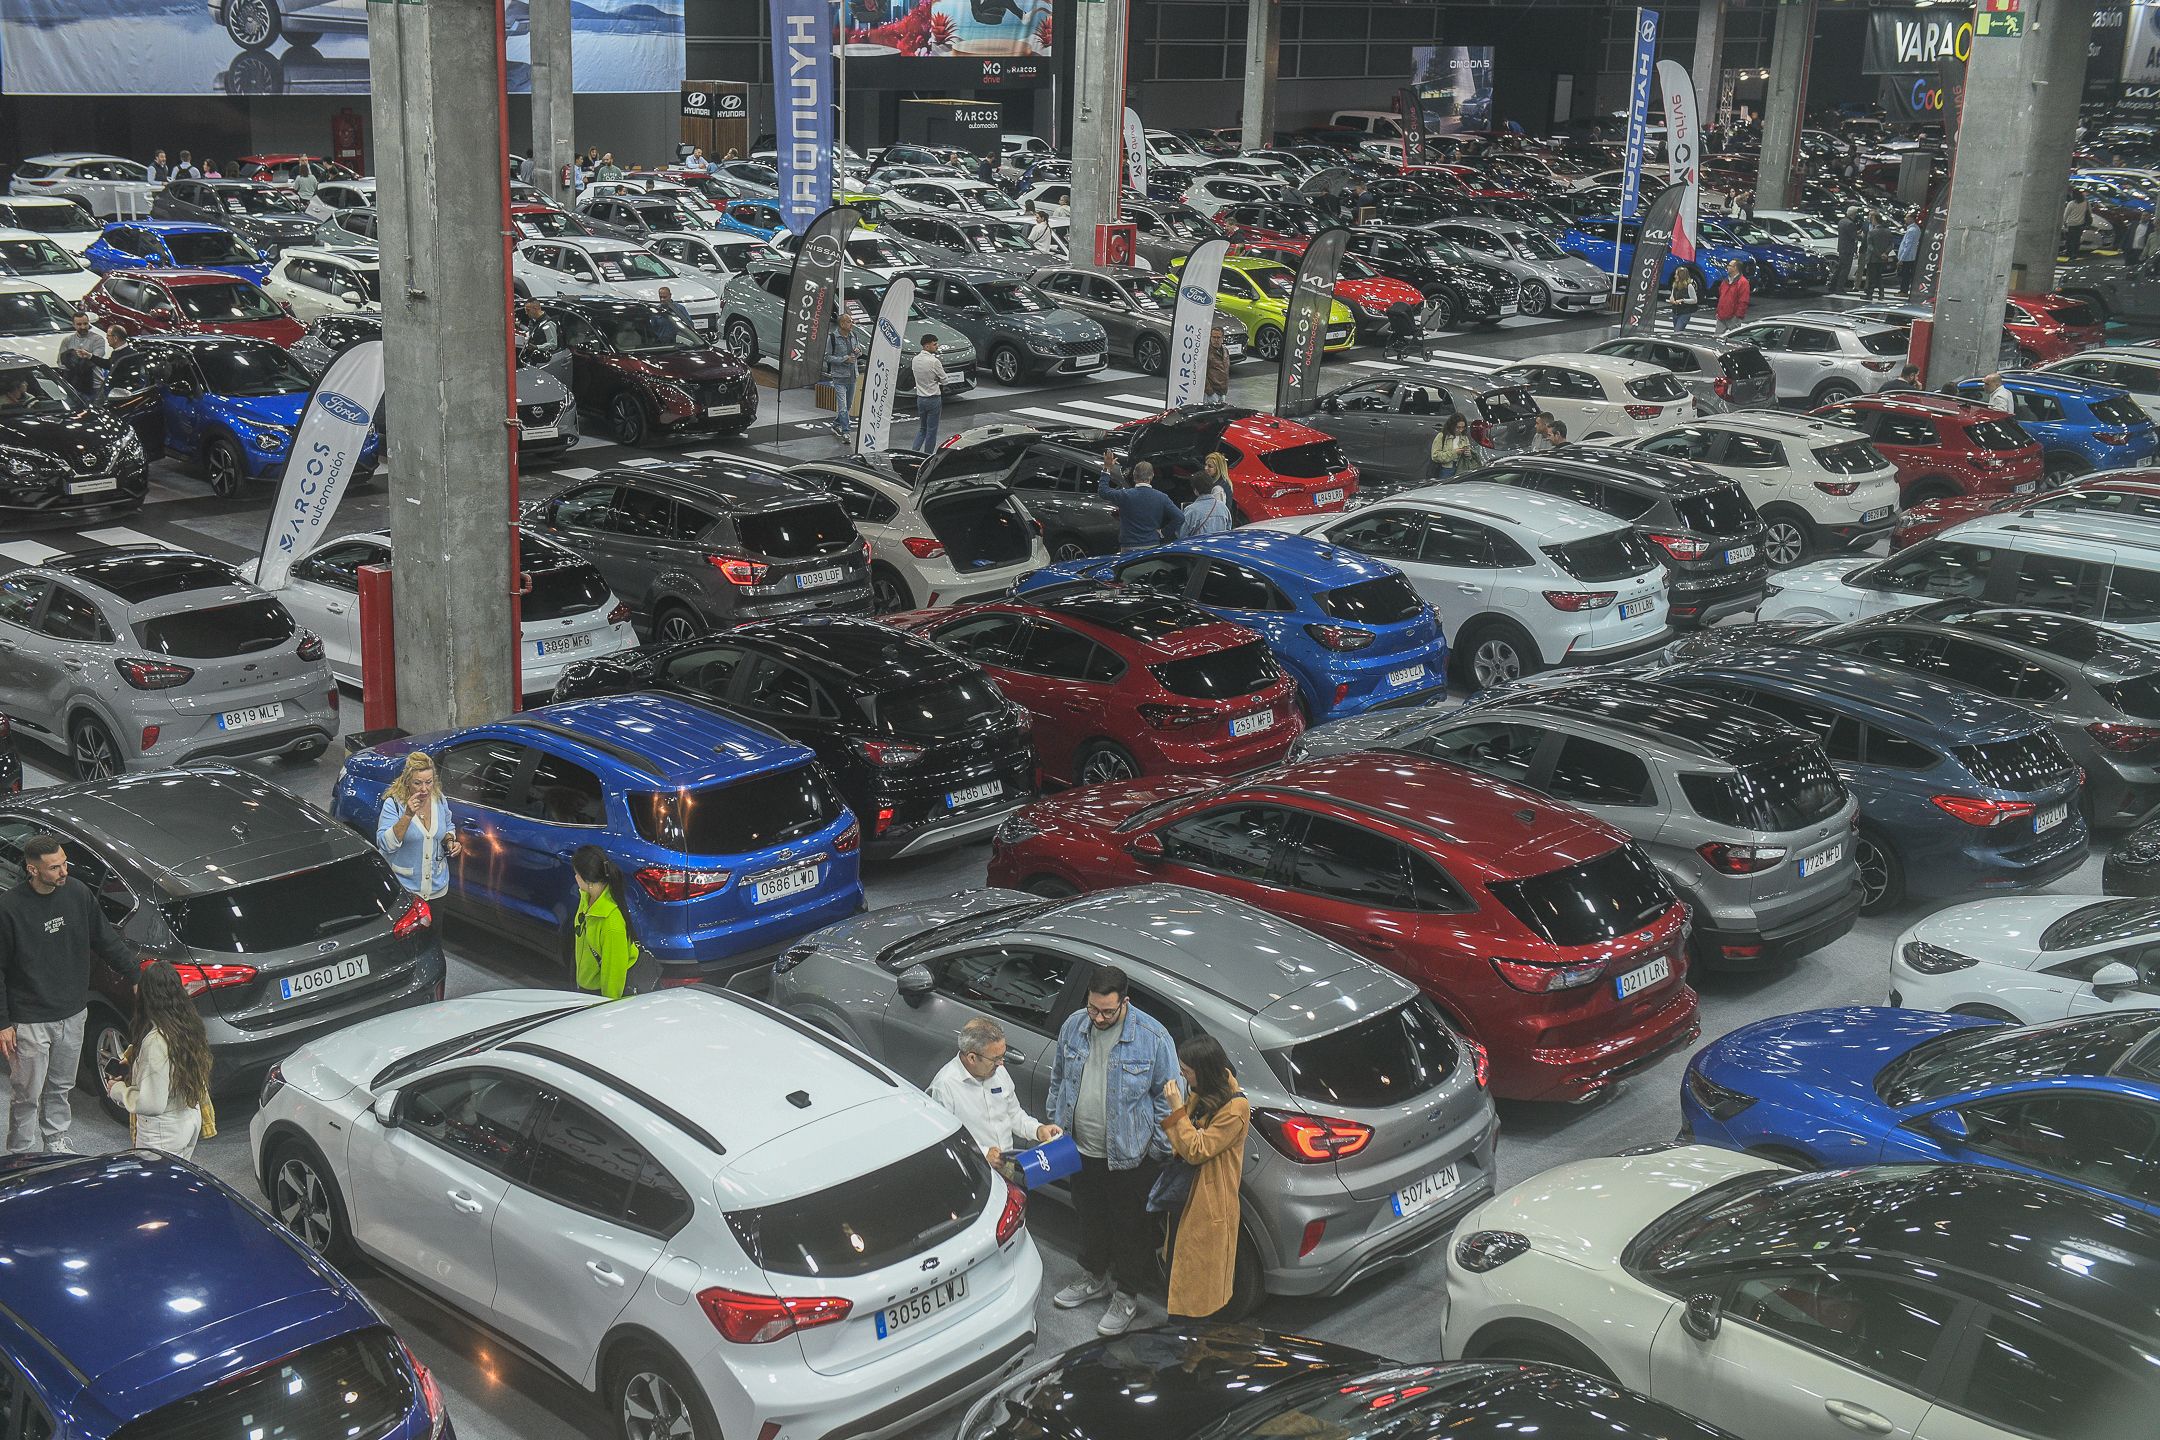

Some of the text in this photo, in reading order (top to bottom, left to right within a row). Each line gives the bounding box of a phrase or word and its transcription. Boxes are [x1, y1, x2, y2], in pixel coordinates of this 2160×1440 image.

[983, 61, 1000, 74] MO
[684, 107, 711, 116] HYUNDAI
[955, 110, 998, 121] MARCOS
[1625, 53, 1650, 201] HYUNDAI
[805, 243, 842, 260] NISSAN
[1919, 232, 1944, 293] MARCOS
[1187, 289, 1207, 304] Ford
[1630, 258, 1655, 326] MARCOS
[790, 280, 819, 362] MARCOS
[810, 287, 827, 341] automoción
[882, 320, 898, 344] Ford
[1289, 307, 1312, 388] MARCOS
[1175, 324, 1194, 406] MARCOS
[326, 397, 358, 422] Ford
[279, 442, 331, 553] MARCOS
[311, 451, 346, 526] automoción
[572, 634, 590, 648] MFG
[226, 704, 279, 726] 8819 MLF
[953, 783, 1000, 804] 5486 LVM
[2038, 809, 2053, 829] 2322
[1805, 853, 1823, 872] 7726
[761, 869, 814, 896] 0686 LWD
[294, 958, 364, 992] 4060 LDY
[1623, 969, 1647, 992] 0211
[1401, 1165, 1455, 1206] 5074 LZN
[888, 1276, 965, 1329] 3056 LWJ
